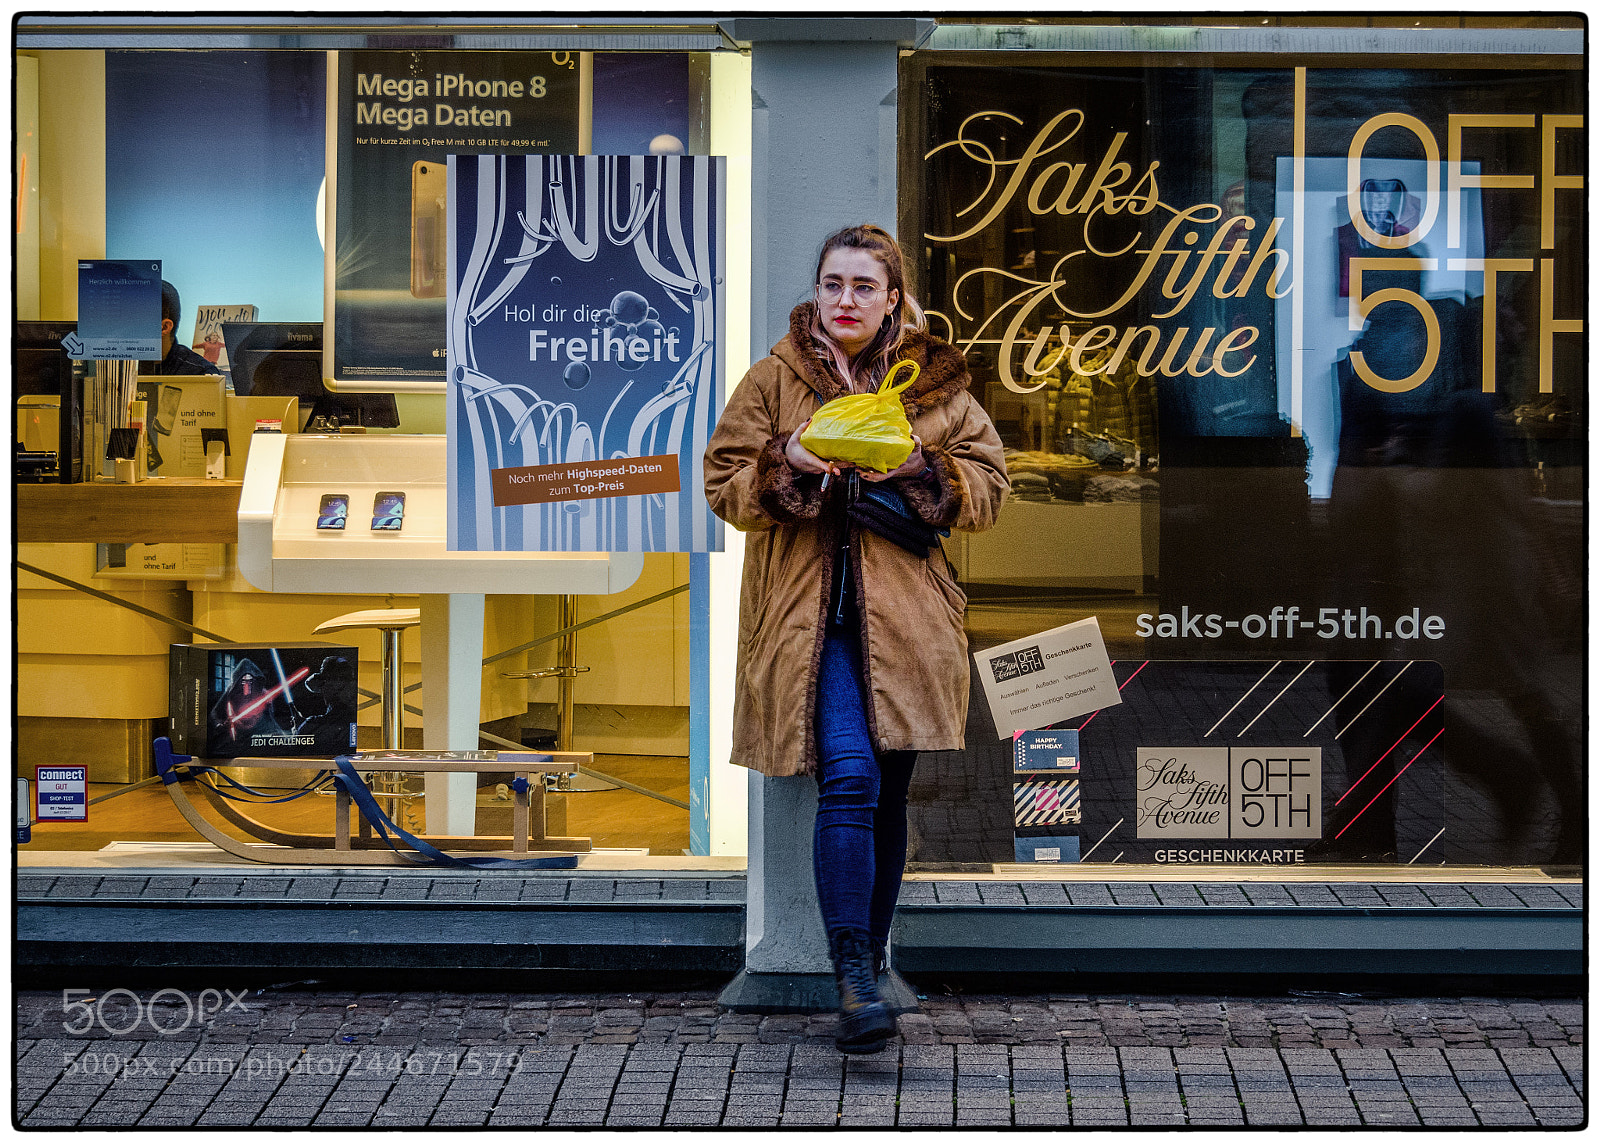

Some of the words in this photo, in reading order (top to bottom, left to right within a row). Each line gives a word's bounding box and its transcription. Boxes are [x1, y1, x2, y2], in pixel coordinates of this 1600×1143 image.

[357, 74, 429, 102] Mega
[436, 73, 524, 98] iPhone
[529, 75, 547, 98] 8
[357, 102, 429, 131] Mega
[435, 103, 512, 127] Daten
[356, 137, 368, 145] Nur
[370, 137, 379, 145] für
[380, 137, 398, 145] kurze
[399, 137, 411, 145] Zeit
[431, 138, 445, 146] Free
[446, 138, 454, 146] M
[454, 138, 466, 146] mit
[467, 138, 476, 146] 10
[476, 139, 487, 147] GB
[488, 139, 499, 147] LTE
[500, 138, 510, 147] für
[511, 139, 530, 148] 49,99
[924, 108, 1160, 242] Saks
[1347, 112, 1583, 249] OFF
[1052, 203, 1296, 318] fifth
[504, 304, 535, 322] Hol
[542, 304, 567, 322] dir
[573, 304, 601, 322] die
[925, 266, 1259, 394] Avenue
[529, 328, 680, 362] Freiheit
[508, 473, 535, 484] Noch
[538, 471, 564, 482] mehr
[567, 463, 663, 481] Highspeed-Daten
[549, 486, 571, 496] zum
[573, 480, 625, 495] Top-Preis
[1135, 606, 1446, 640] saks-off-5th.de
[1018, 649, 1039, 662] OFF
[1045, 642, 1092, 660] Geschenkkarte
[1020, 659, 1042, 673] 5TH
[1009, 705, 1029, 716] Immer
[1030, 702, 1041, 710] das
[1042, 695, 1064, 706] richtige
[251, 738, 266, 747] JEDI
[268, 737, 315, 746] CHALLENGES
[40, 769, 83, 780] connect
[1137, 758, 1195, 791] Saks
[1241, 758, 1311, 792] OFF
[1168, 781, 1228, 809] fifth
[1137, 797, 1220, 829] Avenue
[1241, 793, 1311, 828] 5TH
[1154, 849, 1305, 863] GESCHENKKARTE
